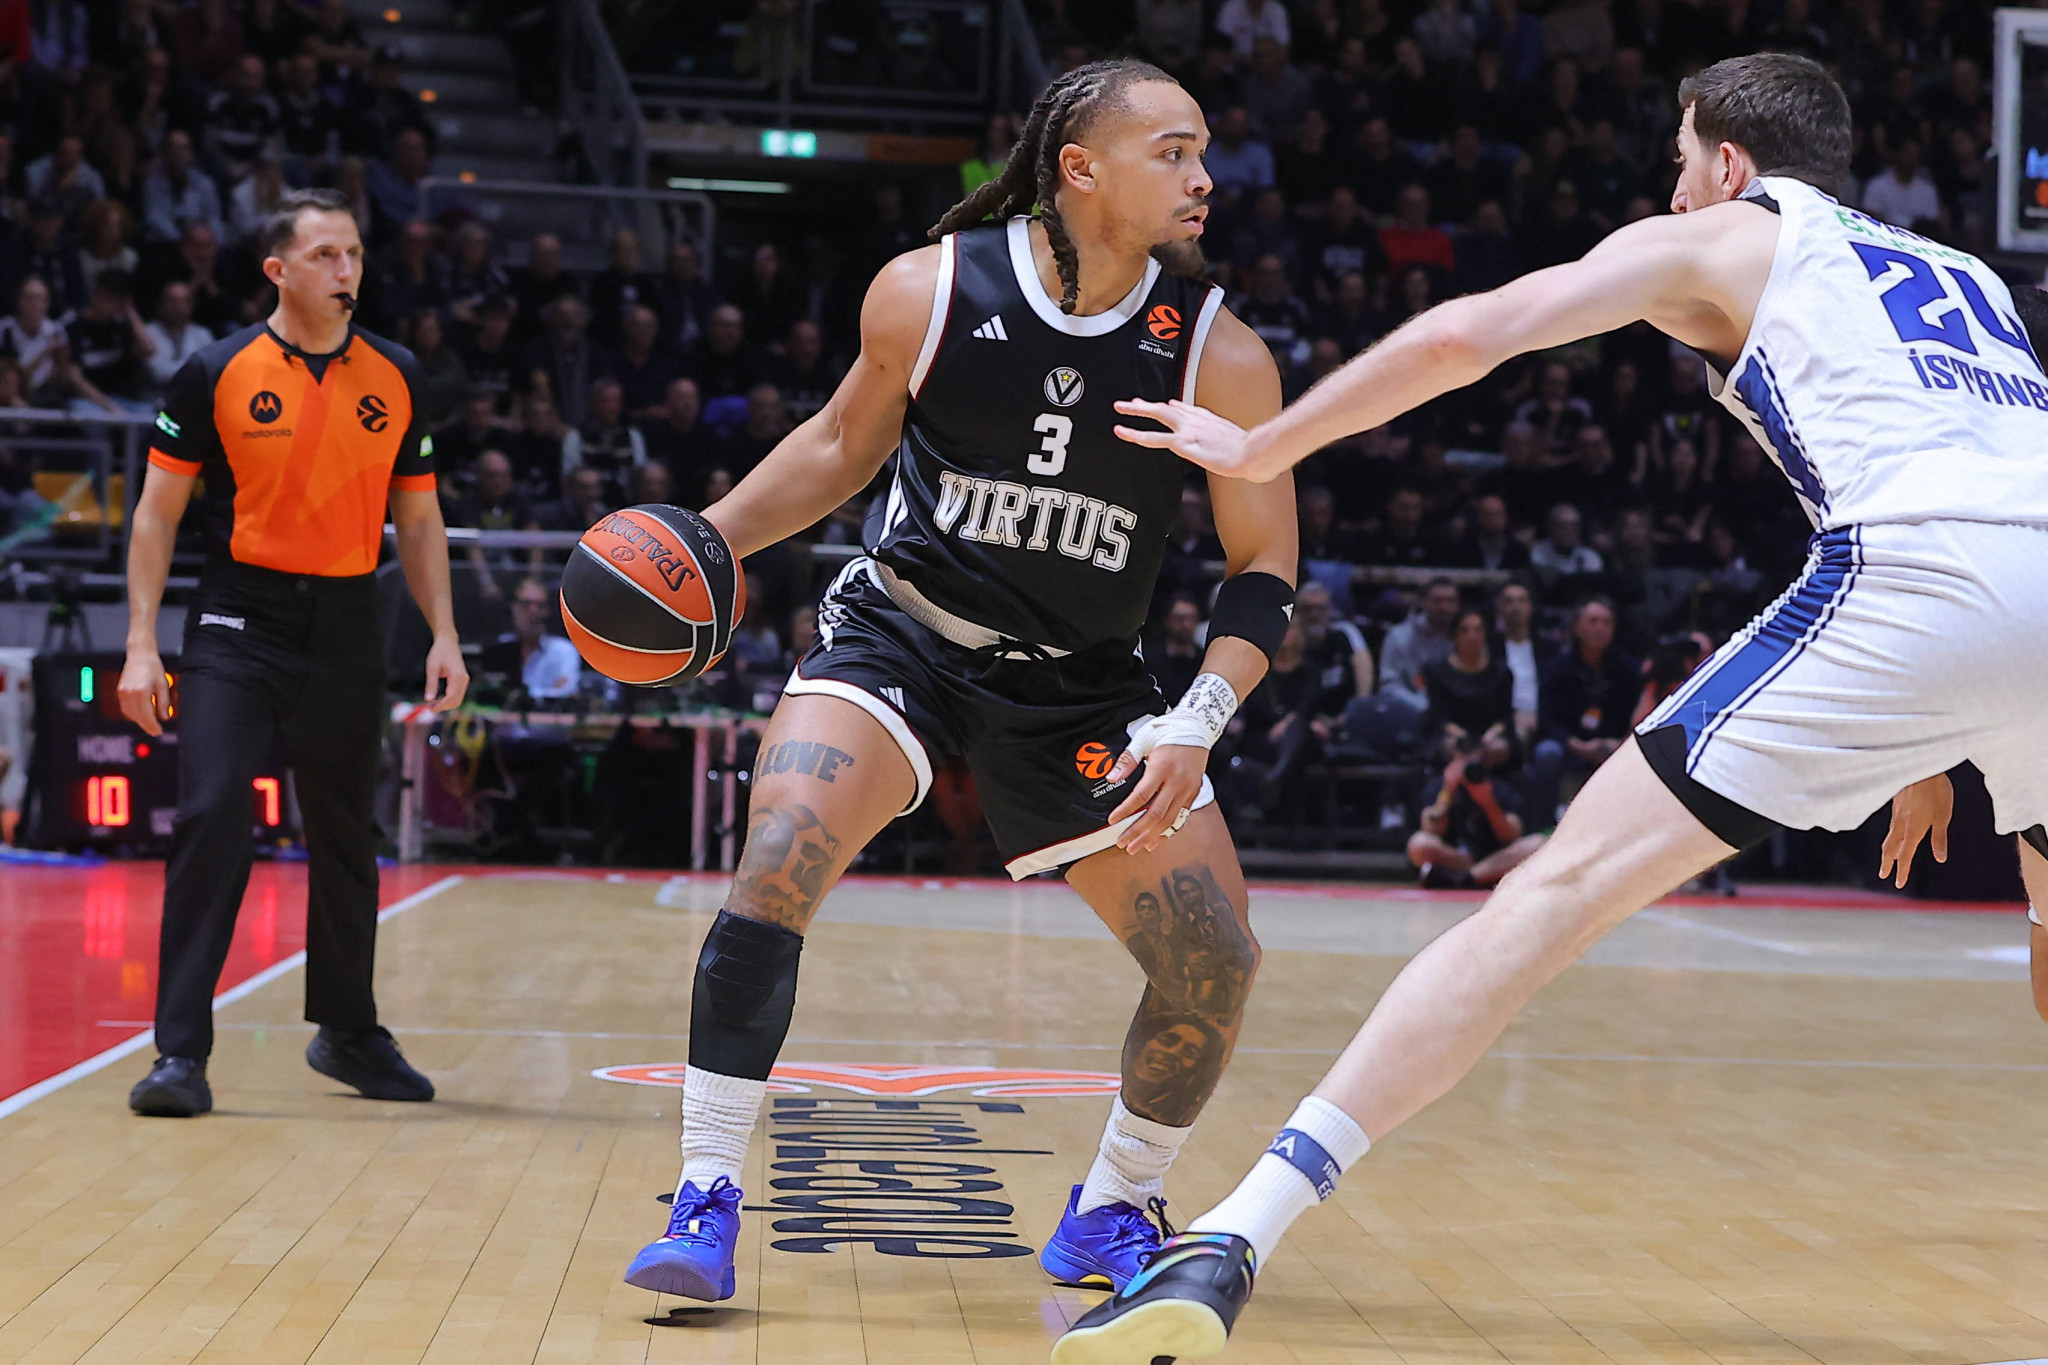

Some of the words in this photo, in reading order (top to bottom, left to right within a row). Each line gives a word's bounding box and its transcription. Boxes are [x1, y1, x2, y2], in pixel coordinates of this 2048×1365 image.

[1138, 343, 1153, 353] abu
[1908, 348, 2048, 412] İSTANB
[1026, 413, 1073, 476] 3
[593, 513, 696, 592] SPALDING
[933, 470, 1138, 572] VIRTUS
[87, 776, 130, 826] 10
[252, 778, 280, 826] 7
